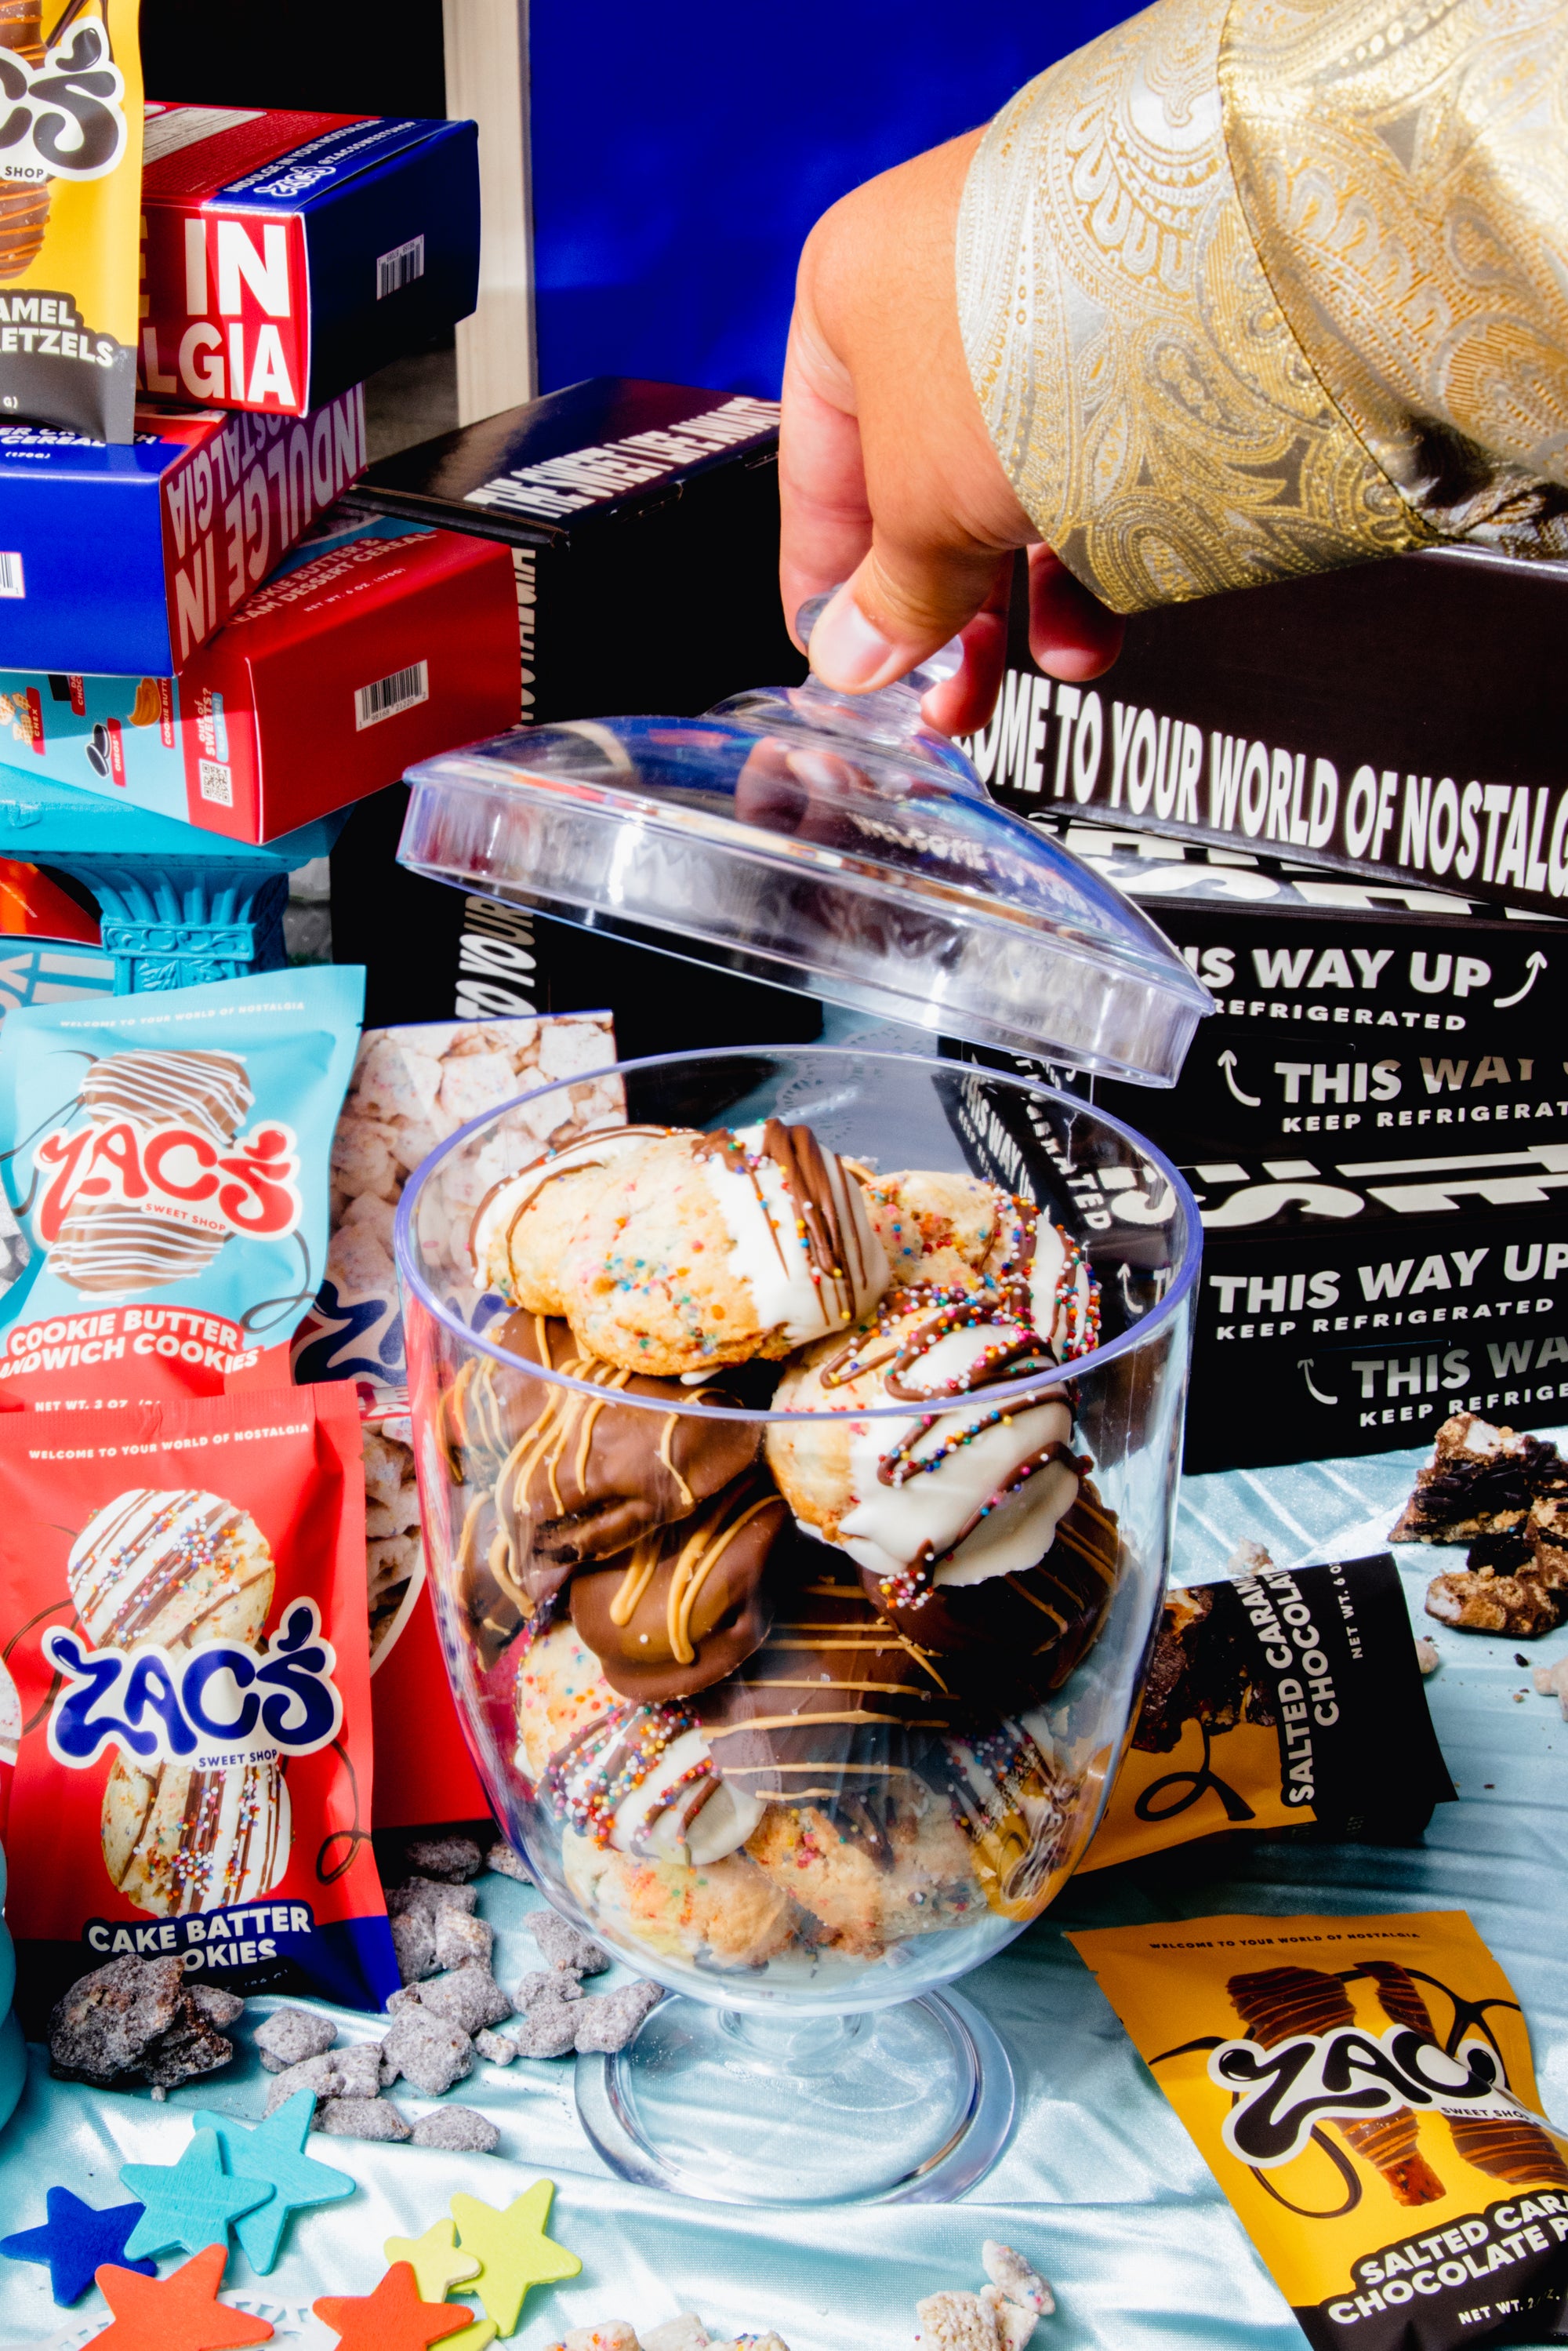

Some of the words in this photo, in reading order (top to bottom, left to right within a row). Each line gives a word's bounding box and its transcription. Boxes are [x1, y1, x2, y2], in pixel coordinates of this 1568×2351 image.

[5, 165, 44, 179] SHOP
[223, 164, 285, 193] INDULGE
[275, 157, 298, 167] IN
[293, 142, 324, 158] YOUR
[317, 120, 385, 146] NOSTALGIA
[184, 218, 291, 318] IN
[0, 326, 114, 369] ETZELS
[136, 322, 296, 407] LGIA
[1, 435, 107, 448] CEREAL
[617, 430, 728, 465] LIFE
[510, 441, 675, 498] SWEET
[225, 380, 368, 608] INDULGE
[463, 478, 596, 519] THE
[278, 560, 355, 602] DESSERT
[352, 532, 438, 563] CEREAL
[290, 543, 364, 580] BUTTER
[359, 539, 383, 551] &
[174, 529, 217, 663] IN
[303, 601, 325, 612] NET
[31, 708, 41, 738] CHEX
[162, 708, 172, 746] COOKIE
[201, 687, 216, 757] SWEETS?
[1054, 683, 1103, 805] TO
[1110, 700, 1203, 825] YOUR
[1210, 731, 1339, 849] WORLD
[1344, 765, 1399, 861] OF
[1251, 947, 1396, 989] WAY
[1409, 951, 1492, 998] UP
[59, 1019, 117, 1029] WELCOME
[140, 1015, 172, 1025] YOUR
[174, 1009, 216, 1021] WORLD
[218, 1006, 236, 1017] OF
[237, 1001, 306, 1014] NOSTALGIA
[1274, 1059, 1402, 1104] THIS
[1282, 1114, 1363, 1134] KEEP
[144, 1201, 188, 1221] SWEET
[191, 1214, 227, 1233] SHOP
[1209, 1270, 1341, 1314] THIS
[1357, 1248, 1490, 1303] WAY
[1503, 1242, 1568, 1283] UP
[10, 1313, 118, 1357] COOKIE
[123, 1309, 238, 1352] BUTTER
[1216, 1321, 1298, 1341] KEEP
[1312, 1297, 1555, 1334] REFRIGERATED
[132, 1333, 260, 1374] COOKIES
[1351, 1347, 1472, 1400] THIS
[34, 1401, 62, 1412] NET
[65, 1400, 90, 1411] WT.
[93, 1399, 103, 1409] 3
[1359, 1404, 1435, 1428] KEEP
[28, 1449, 95, 1459] WELCOME
[99, 1447, 118, 1458] TO
[121, 1443, 158, 1455] YOUR
[161, 1435, 209, 1452] WORLD
[212, 1432, 230, 1445] OF
[233, 1423, 310, 1443] NOSTALGIA
[1345, 1626, 1364, 1660] NET
[198, 1753, 246, 1768] SWEET
[249, 1748, 278, 1763] SHOP
[1277, 1677, 1316, 1804] SALTED
[88, 1924, 178, 1954] CAKE
[185, 1906, 313, 1944] BATTER
[1239, 1938, 1275, 1946] YOUR
[1277, 1935, 1323, 1944] WORLD
[181, 1938, 278, 1973] OKIES
[1440, 2106, 1489, 2117] SWEET
[1359, 2219, 1490, 2286] SALTED
[1327, 2224, 1551, 2325] CHOCOLATE
[1457, 2306, 1491, 2326] NET
[1494, 2298, 1524, 2316] WT.
